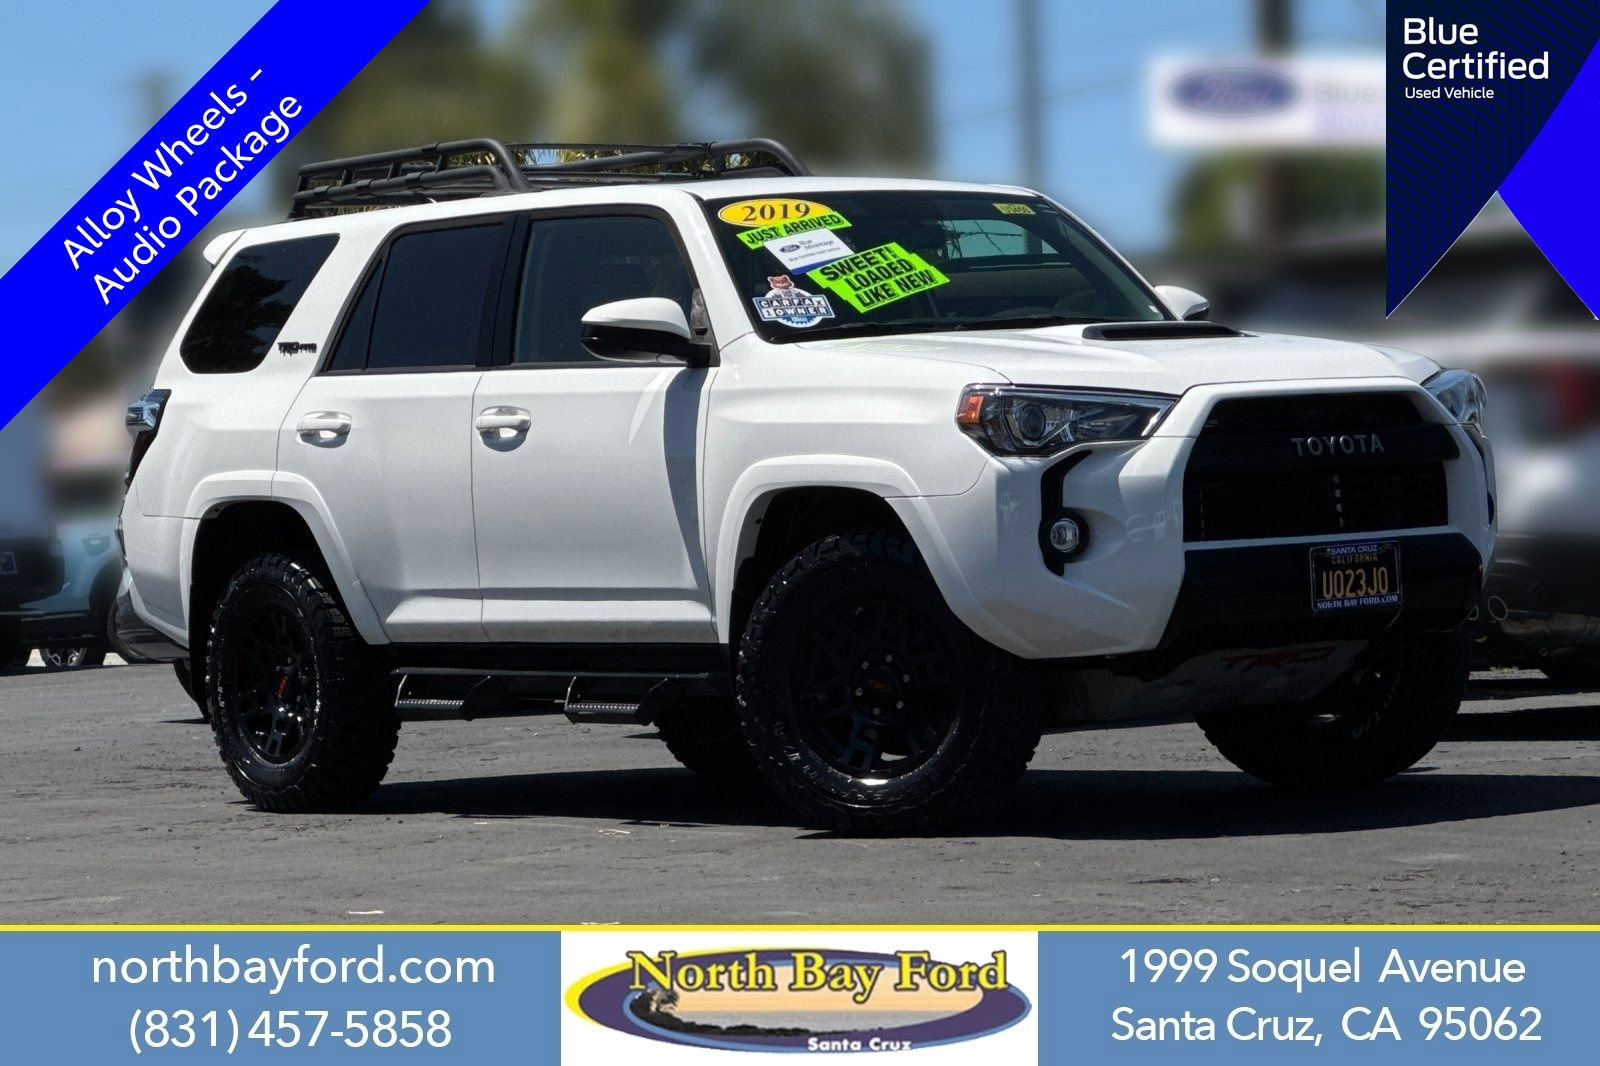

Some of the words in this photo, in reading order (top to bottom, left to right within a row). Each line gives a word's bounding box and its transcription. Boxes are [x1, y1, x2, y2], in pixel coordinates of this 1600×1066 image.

[742, 203, 810, 222] 2019
[746, 226, 781, 244] JUST
[782, 214, 842, 235] ARRIVED
[819, 246, 899, 281] SWEET!
[844, 259, 917, 292] LOADED
[855, 282, 898, 308] LIKE
[893, 269, 937, 294] NEW
[760, 297, 827, 308] CARFAX
[775, 307, 828, 317] OWNER
[1291, 434, 1385, 456] TOYOTA
[1330, 546, 1357, 555] SANTA
[1357, 544, 1378, 553] CRUZ
[1317, 600, 1342, 610] NORTH
[1344, 598, 1359, 607] BAY
